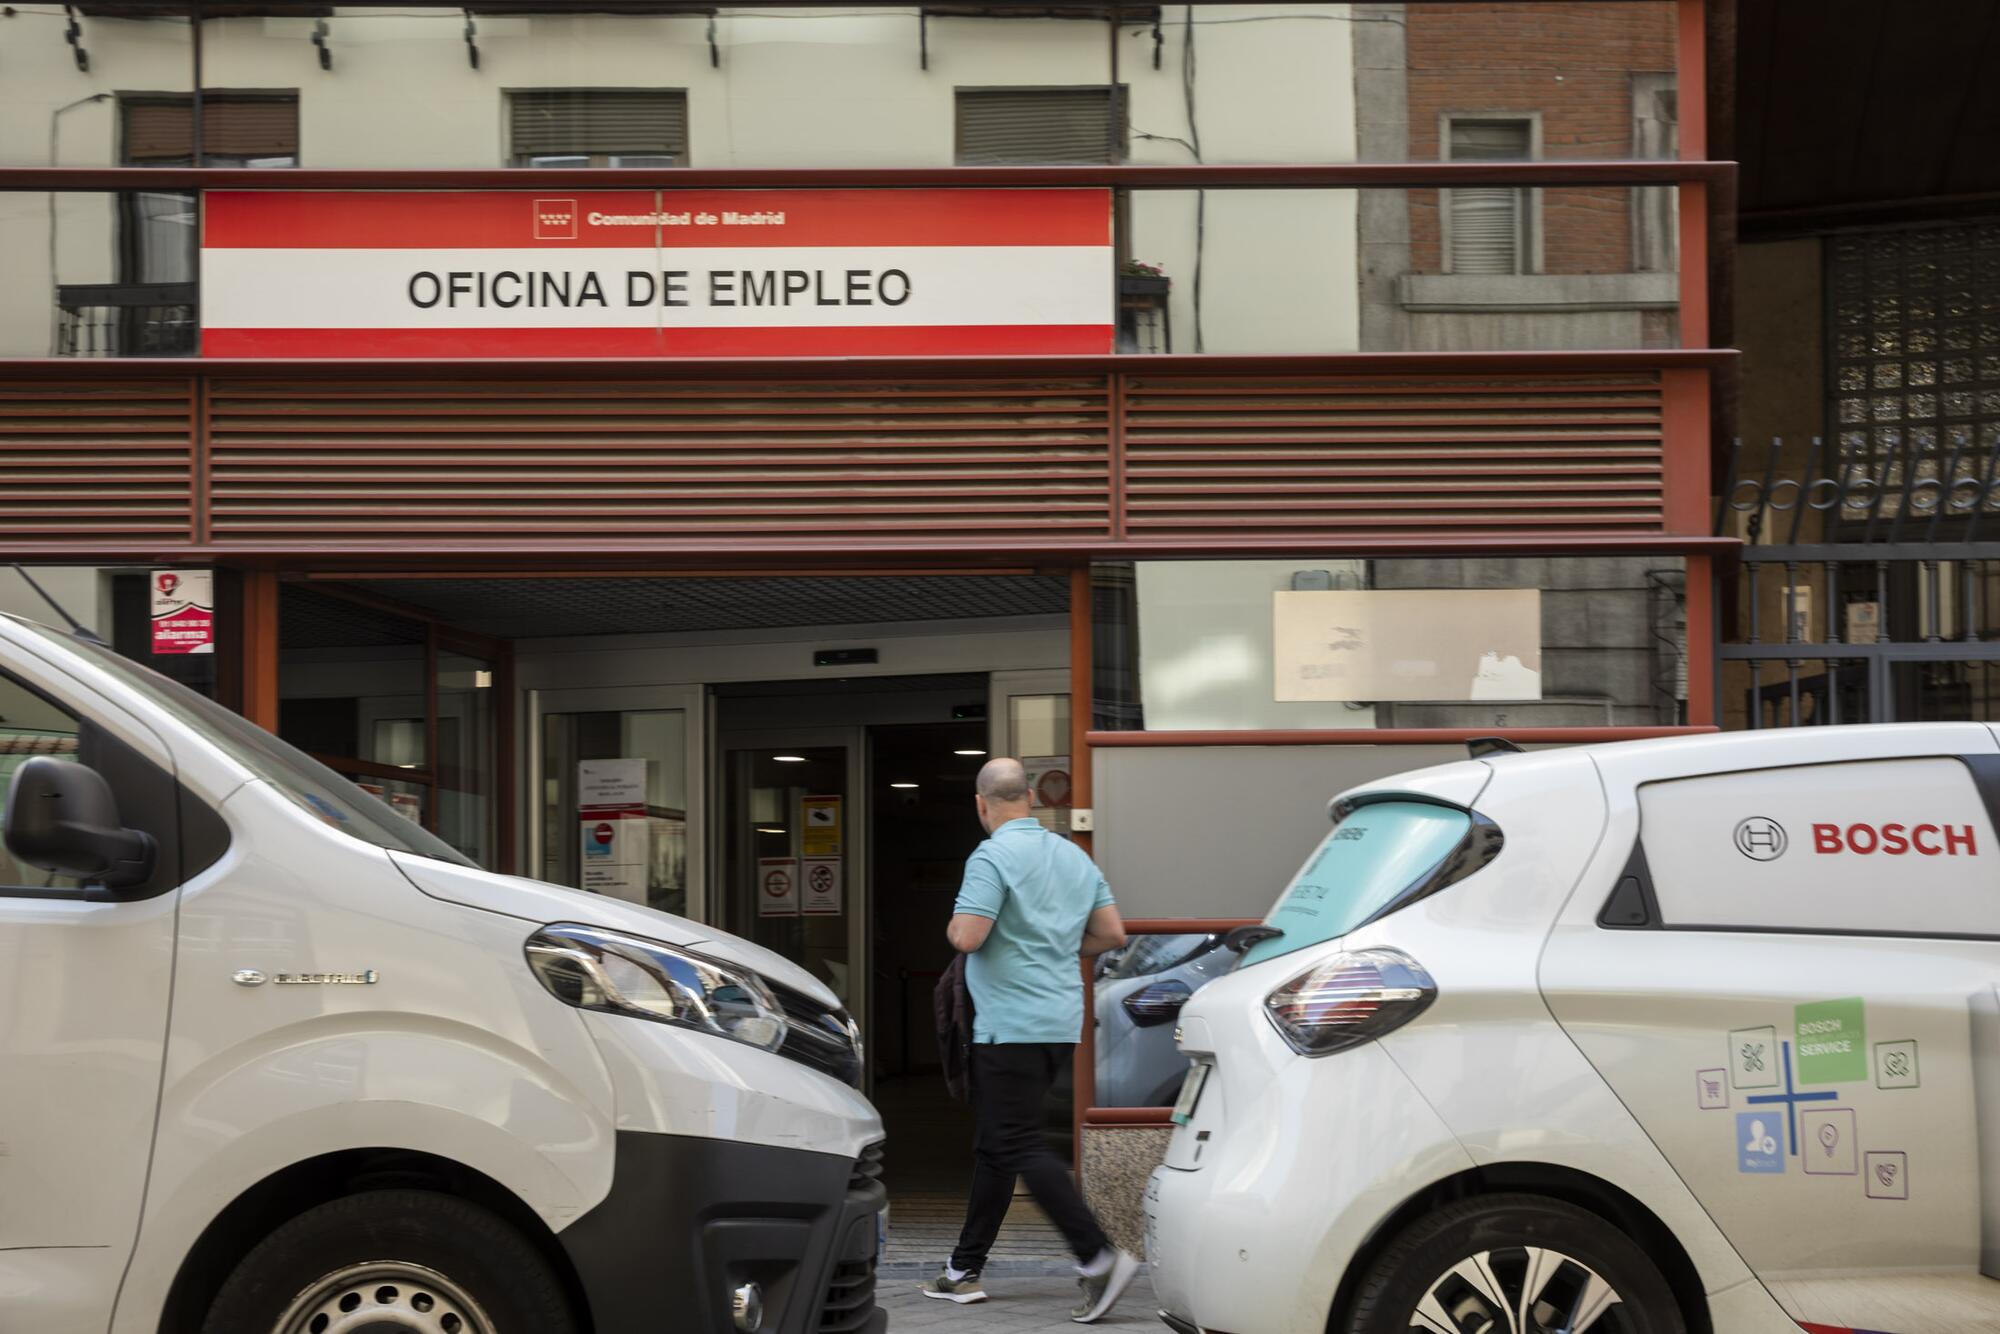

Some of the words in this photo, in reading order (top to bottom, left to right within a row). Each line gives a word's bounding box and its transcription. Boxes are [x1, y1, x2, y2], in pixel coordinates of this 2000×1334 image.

[587, 210, 691, 226] Comunidad
[695, 211, 718, 225] de
[722, 210, 785, 225] Madrid
[407, 270, 608, 309] OFICINA
[626, 270, 690, 307] DE
[708, 268, 912, 307] EMPLEO
[1811, 822, 1979, 857] BOSCH
[1799, 1018, 1842, 1036] BOSCH
[1799, 1039, 1852, 1057] SERVICE
